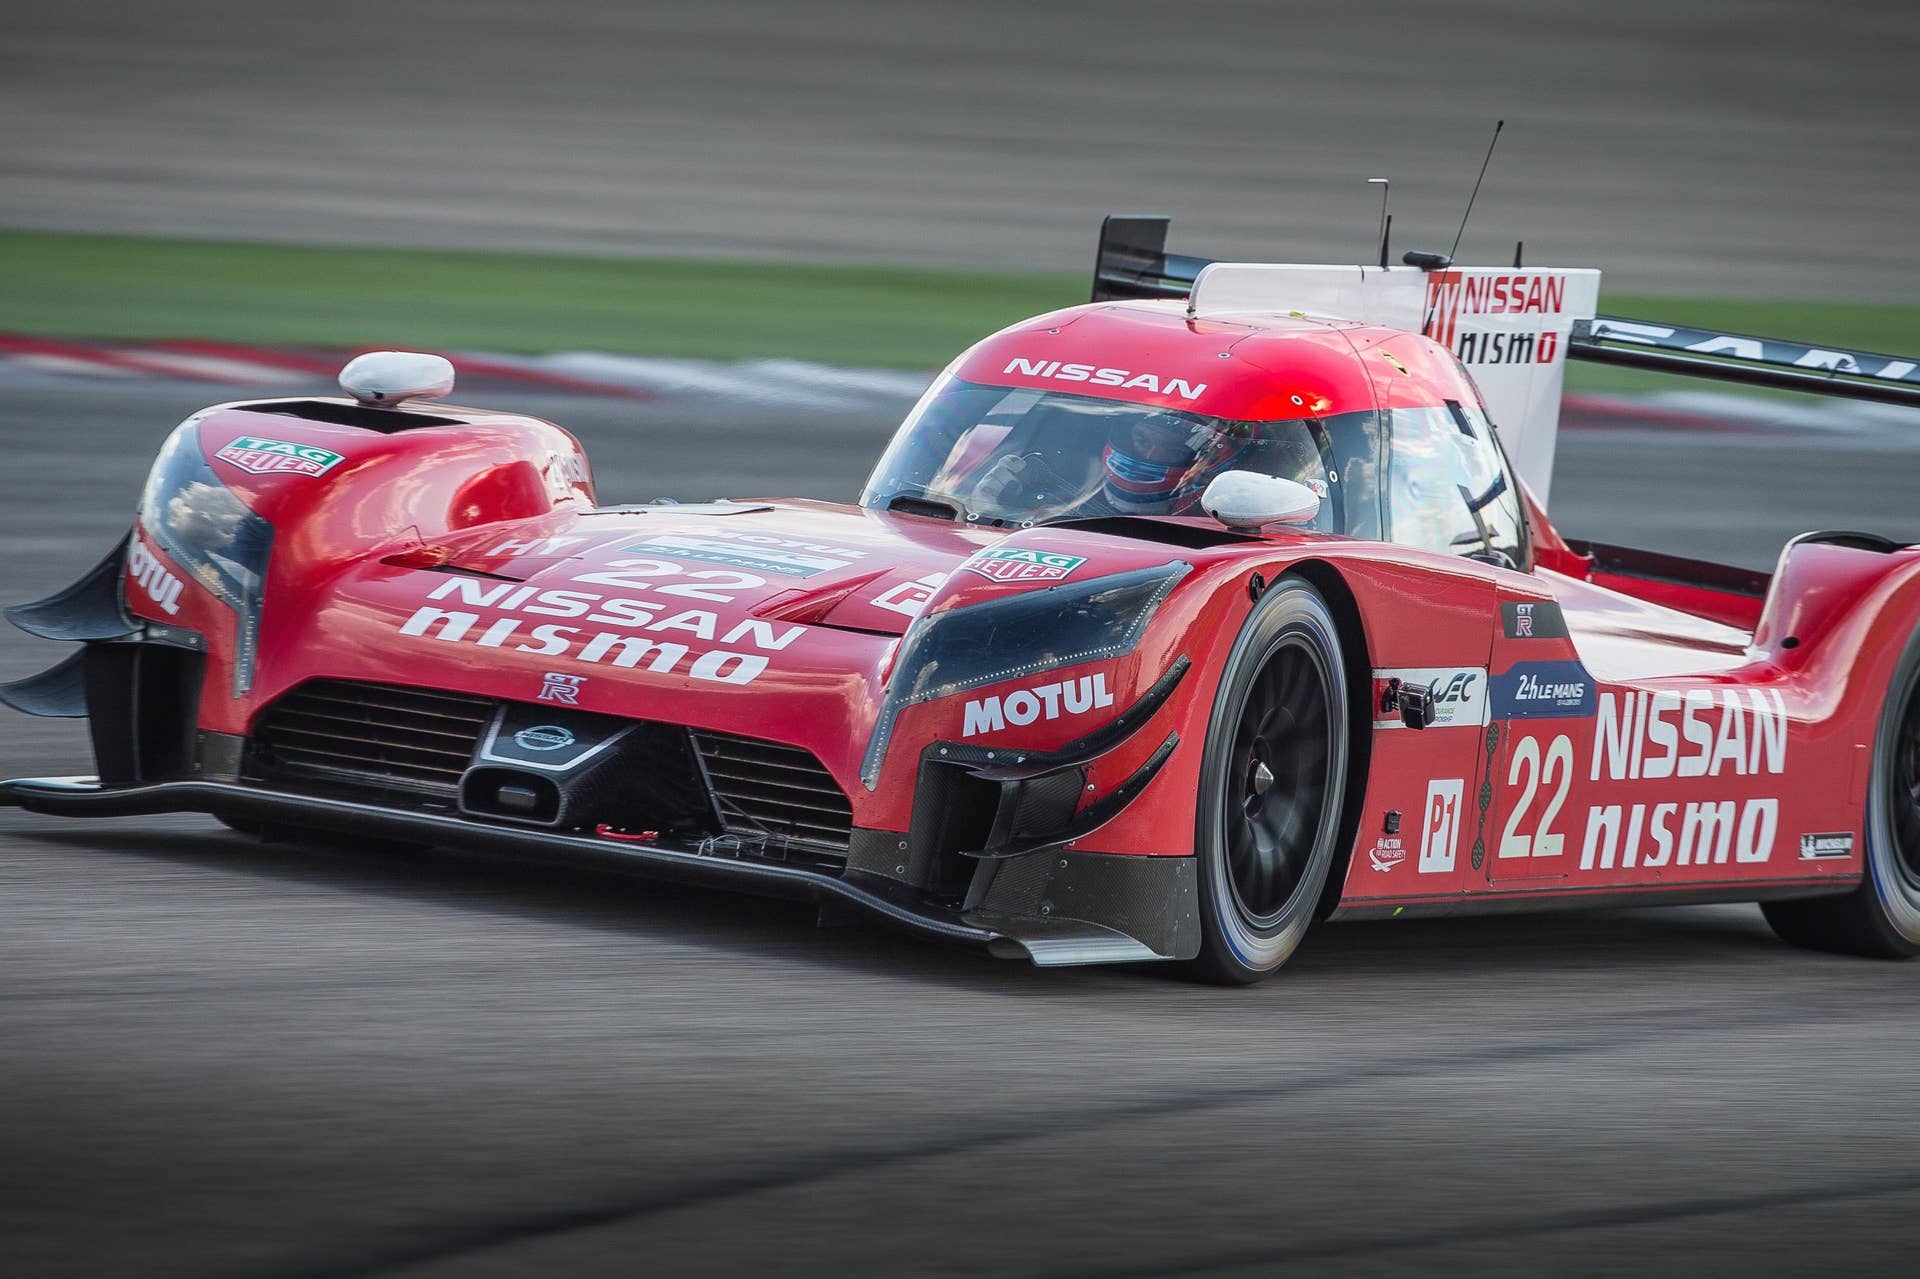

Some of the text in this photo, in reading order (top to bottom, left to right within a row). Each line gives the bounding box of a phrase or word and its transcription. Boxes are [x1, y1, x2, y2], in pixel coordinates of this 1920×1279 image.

[1463, 276, 1565, 314] NISSAN
[1003, 358, 1208, 400] NISSAN
[222, 448, 321, 473] HEUER
[245, 439, 332, 463] TAG
[129, 531, 184, 615] OTUL
[571, 559, 767, 604] 22
[990, 549, 1073, 567] TAG
[399, 605, 770, 686] nismo
[426, 577, 807, 651] NISSAN
[962, 673, 1114, 737] MOTUL
[1590, 688, 1787, 782] NISSAN
[1426, 793, 1456, 859] P1
[1498, 734, 1573, 859] 22
[1579, 798, 1779, 871] nismo
